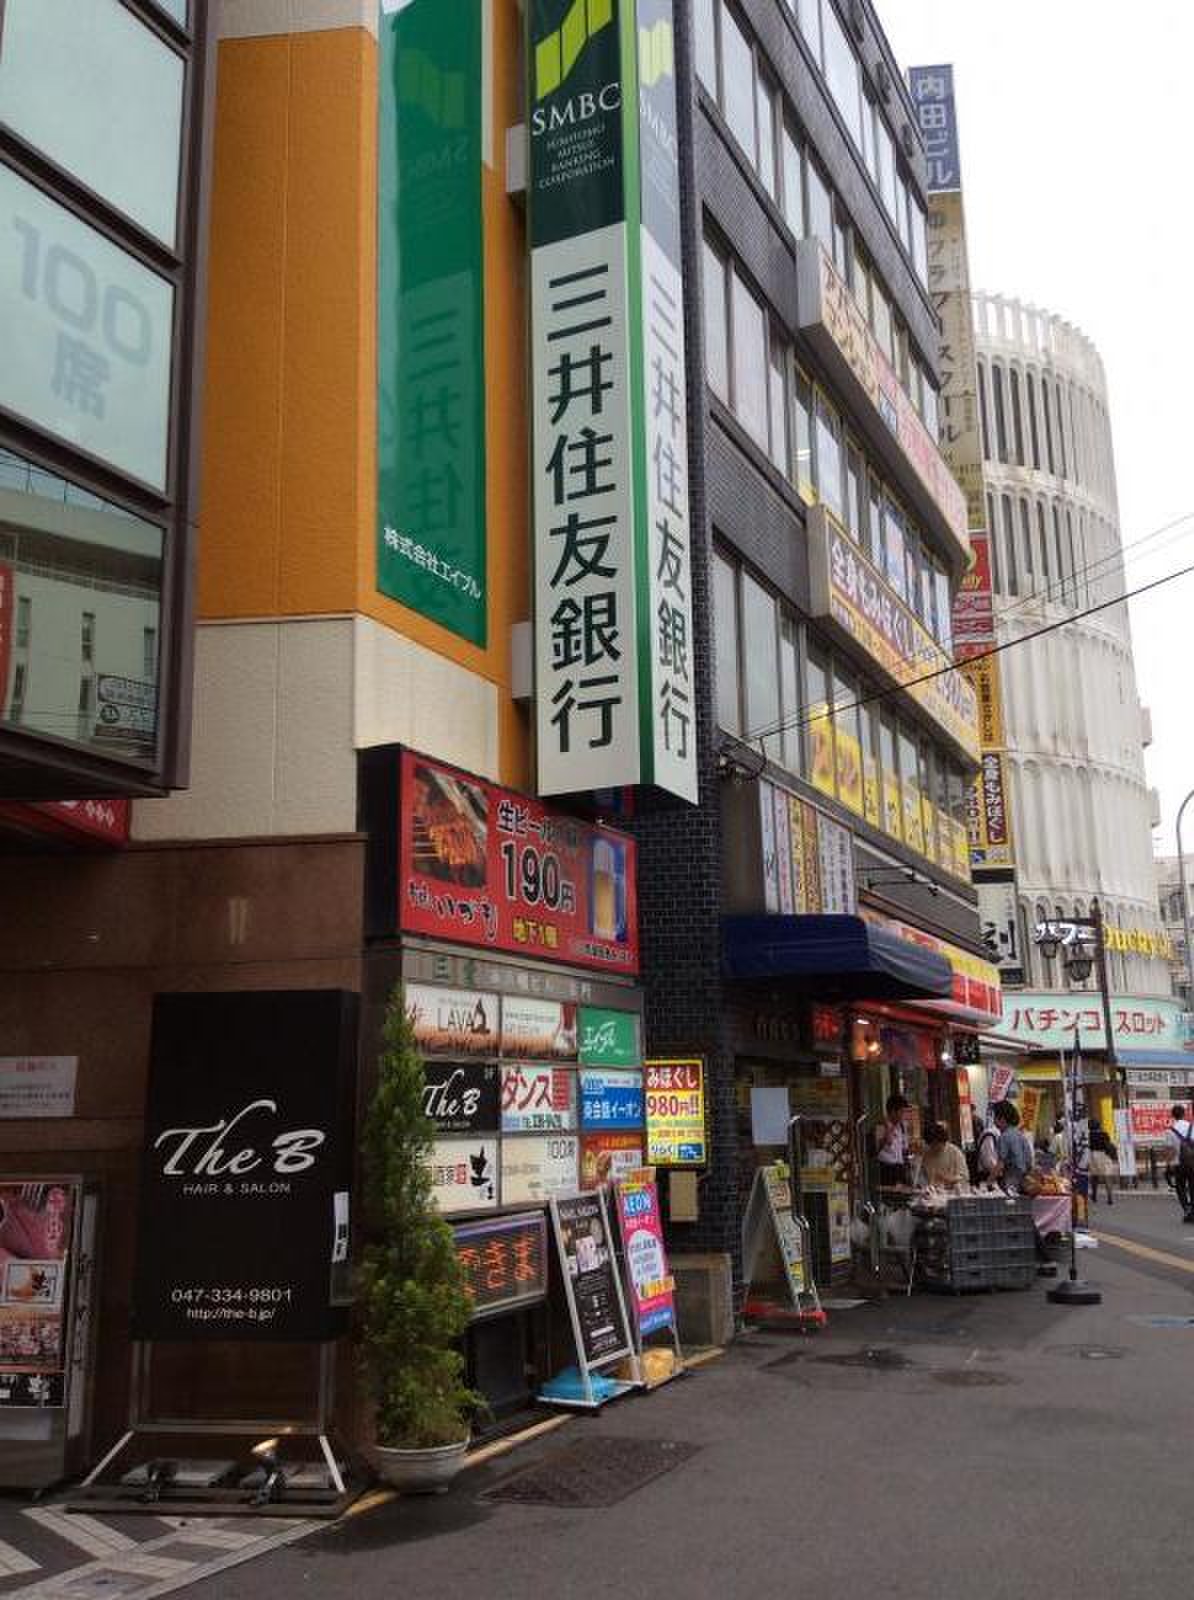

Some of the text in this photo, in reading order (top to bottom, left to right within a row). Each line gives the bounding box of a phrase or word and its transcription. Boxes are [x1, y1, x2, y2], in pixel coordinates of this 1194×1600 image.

[532, 83, 621, 136] SMBC
[545, 262, 621, 754] 三井住友銀行
[650, 275, 691, 761] 三井住友銀行
[383, 525, 482, 600] 株式会社エイブル
[501, 841, 577, 915] 190円
[1012, 1007, 1166, 1034] パチンコ スロット
[422, 1068, 481, 1117] The B
[501, 1067, 553, 1112] ダンス
[153, 1099, 326, 1176] The B
[183, 1182, 291, 1195] HAIR & SALON
[171, 1288, 292, 1304] 047-334-9801
